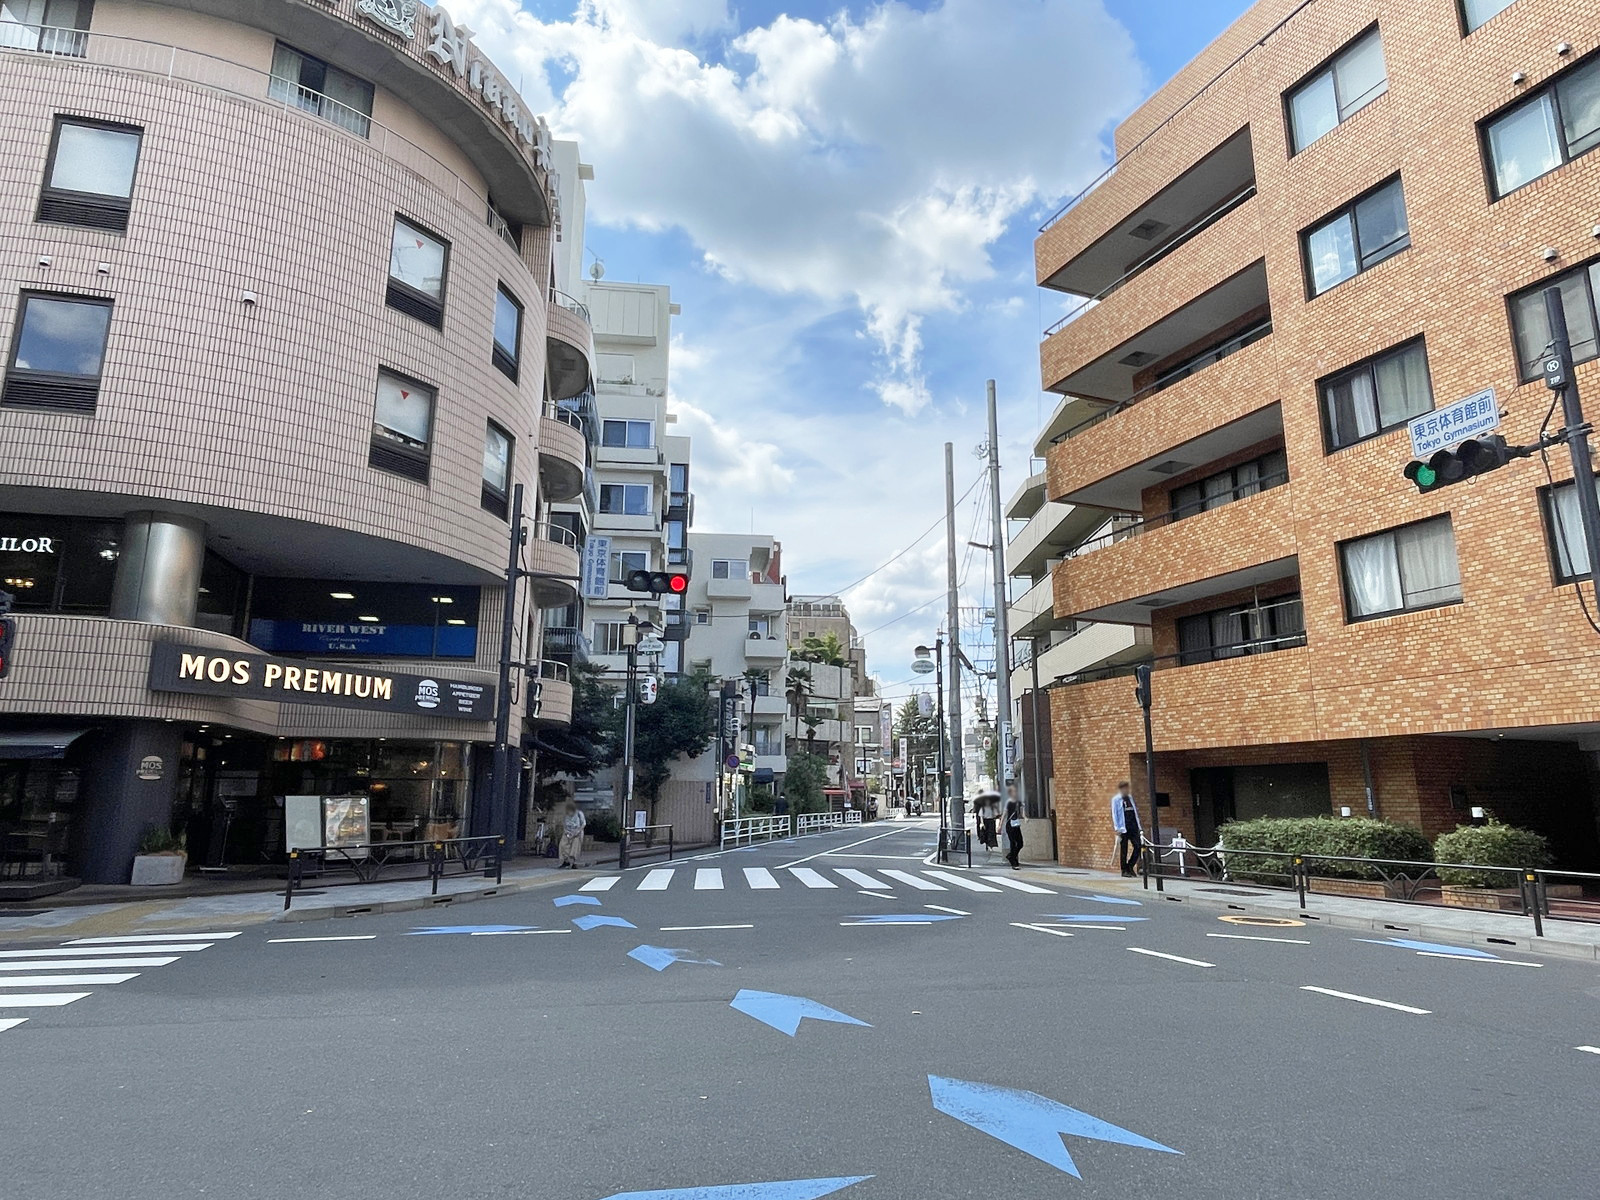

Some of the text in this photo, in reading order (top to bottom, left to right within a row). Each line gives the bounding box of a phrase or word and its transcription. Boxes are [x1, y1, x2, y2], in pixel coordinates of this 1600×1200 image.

[1413, 395, 1493, 441] 東京体育館前
[1417, 416, 1494, 452] Tokyo Gymnasium
[0, 537, 54, 553] ILOR
[302, 623, 387, 635] RIVER WEST
[179, 653, 393, 700] MOS PREMIUM
[418, 686, 438, 697] MOS
[140, 762, 162, 770] MOS
